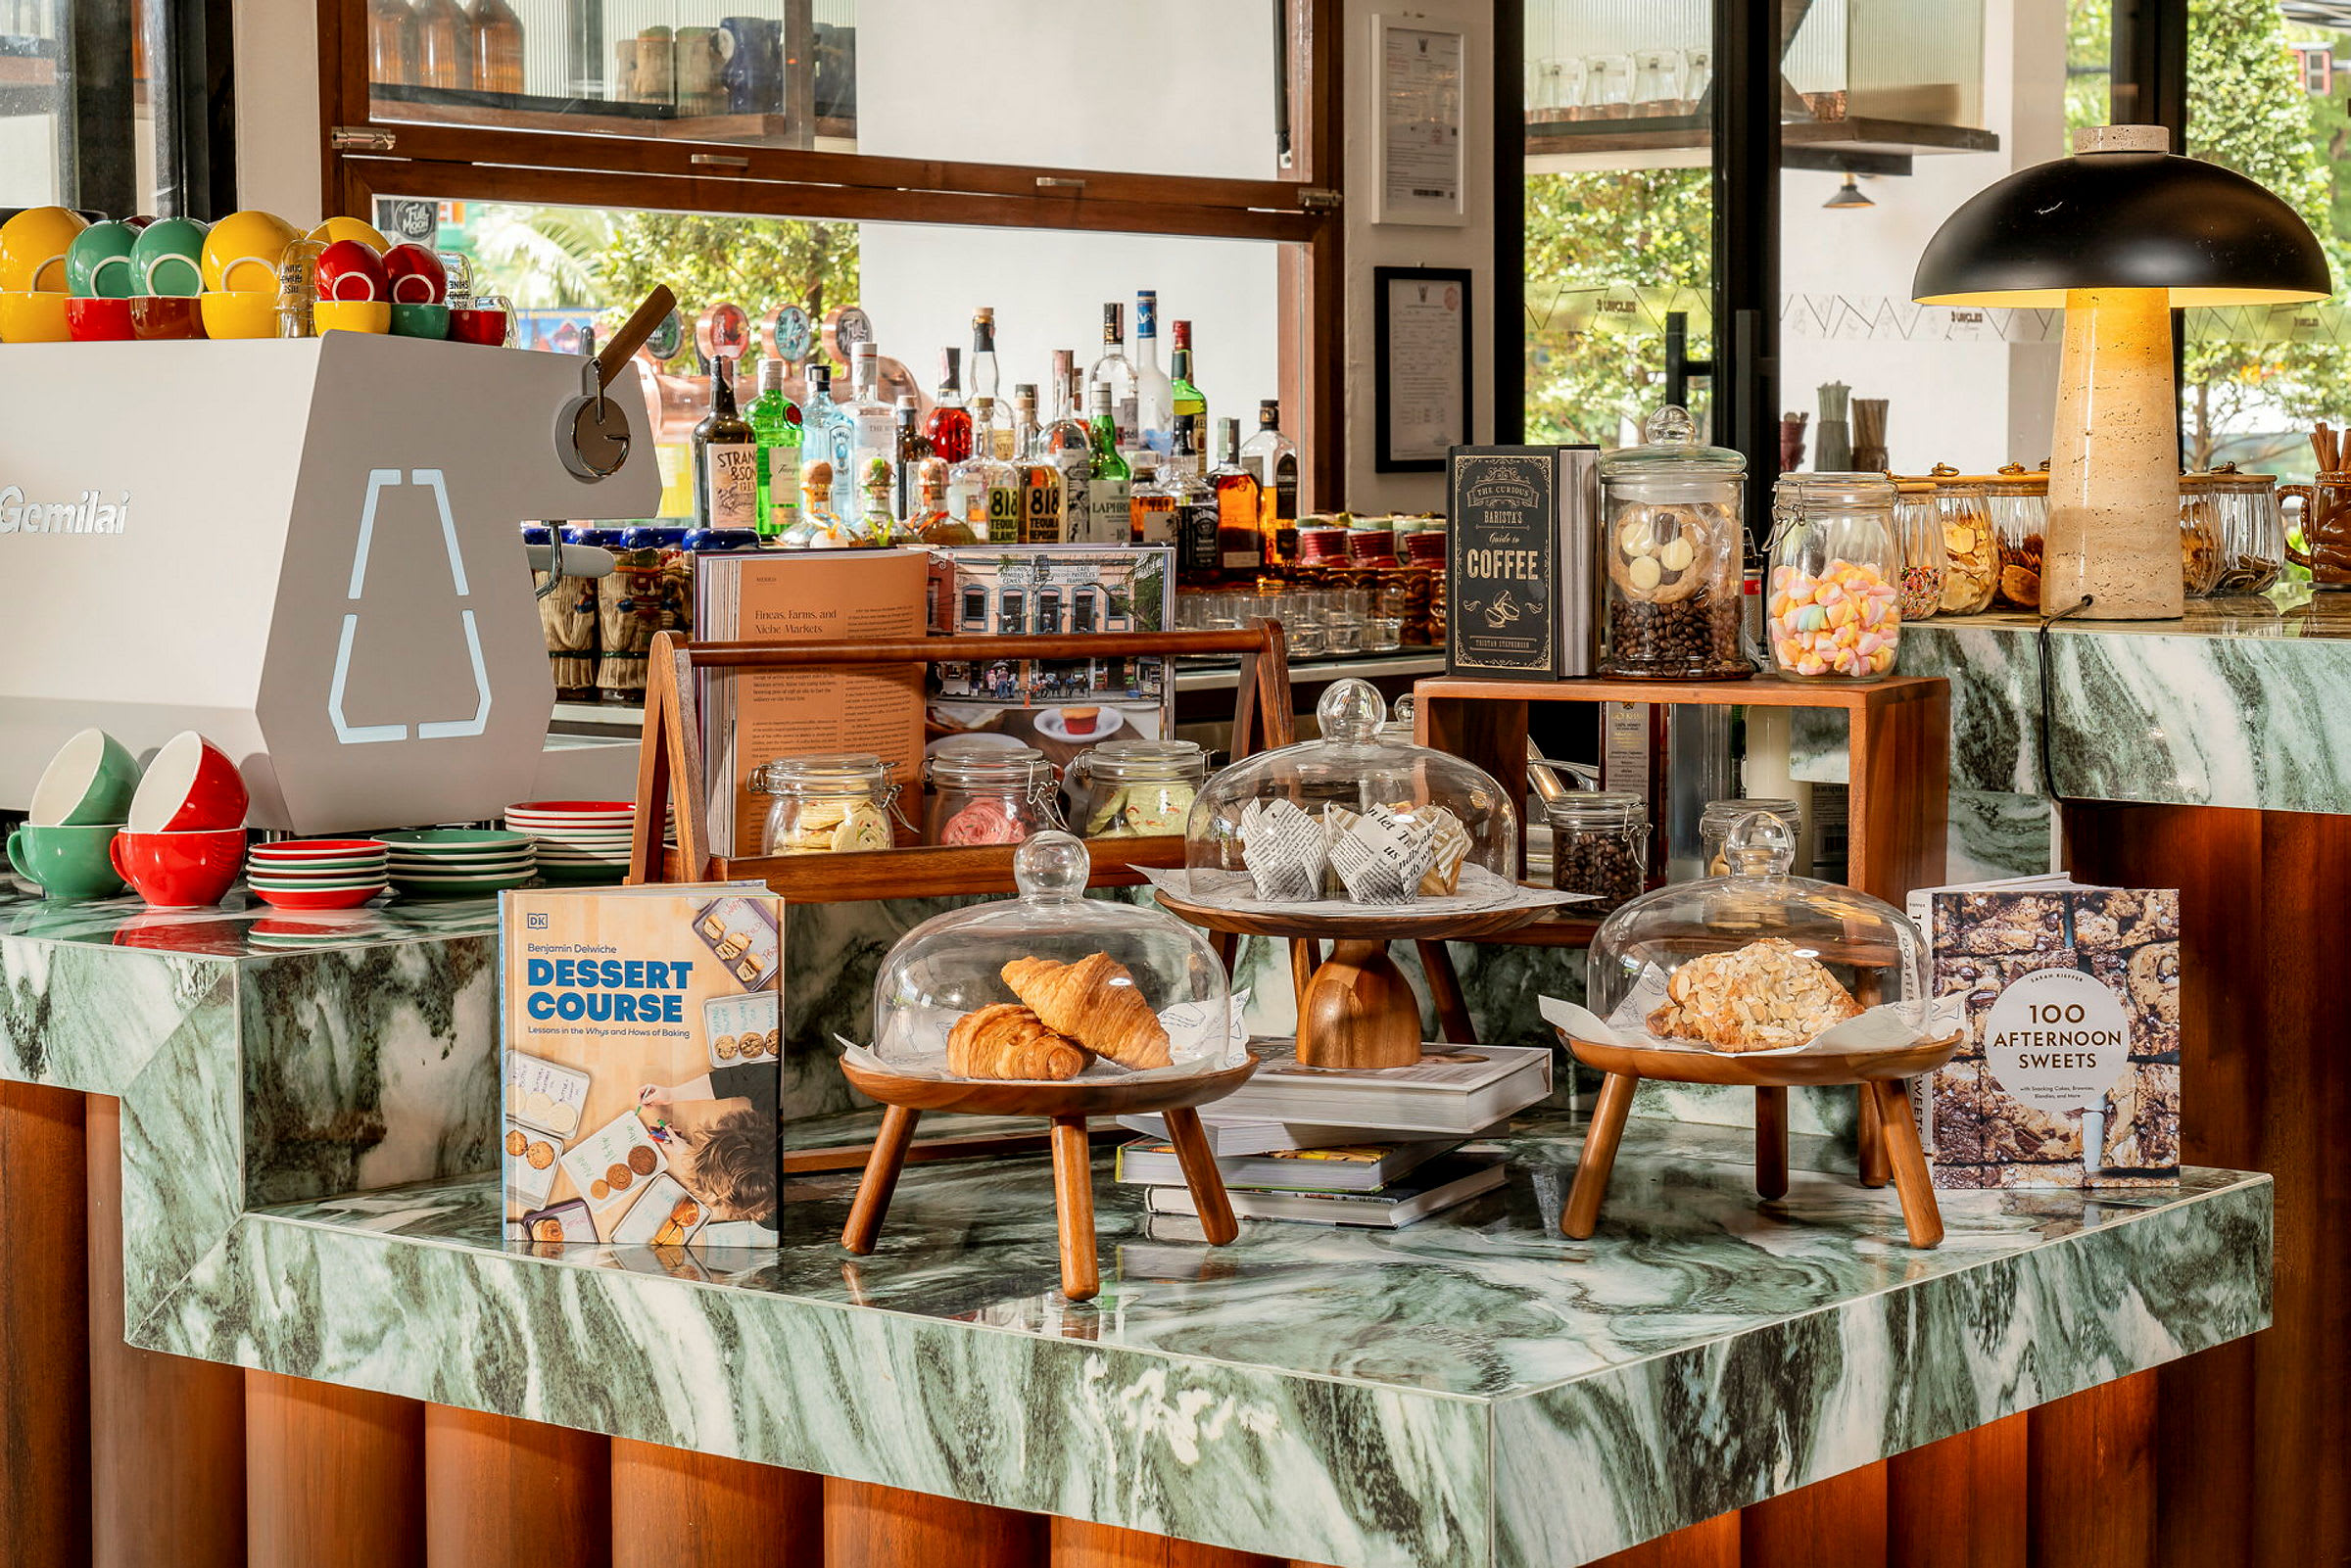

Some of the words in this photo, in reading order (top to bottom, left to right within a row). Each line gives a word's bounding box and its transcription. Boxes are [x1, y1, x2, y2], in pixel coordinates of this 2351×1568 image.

[1476, 487, 1493, 497] THE
[1495, 485, 1529, 498] CURIOUS
[0, 484, 130, 534] Gemilai
[991, 490, 1018, 517] 818
[1031, 489, 1059, 515] 818
[1484, 510, 1523, 524] BARISTA'S
[1488, 531, 1510, 546] Guide
[1511, 536, 1520, 545] to
[1466, 547, 1539, 581] COFFEE
[787, 609, 817, 620] Farms,
[819, 609, 838, 620] and
[755, 625, 782, 635] Niche
[785, 623, 823, 635] Markets
[1376, 813, 1396, 832] let
[1383, 845, 1401, 861] us
[530, 917, 546, 926] DK
[527, 943, 573, 955] Benjamin
[574, 943, 617, 955] Delwiche
[527, 958, 694, 990] DESSERT
[2056, 973, 2084, 982] KIEFFER
[527, 991, 683, 1023] COURSE
[2029, 1003, 2086, 1024] 100
[528, 1025, 560, 1035] Lessons
[561, 1026, 569, 1035] in
[570, 1026, 584, 1035] the
[586, 1027, 610, 1038] Whys
[661, 1029, 691, 1039] Baking
[1993, 1030, 2122, 1047] AFTERNOON
[2018, 1052, 2097, 1069] SWEETS
